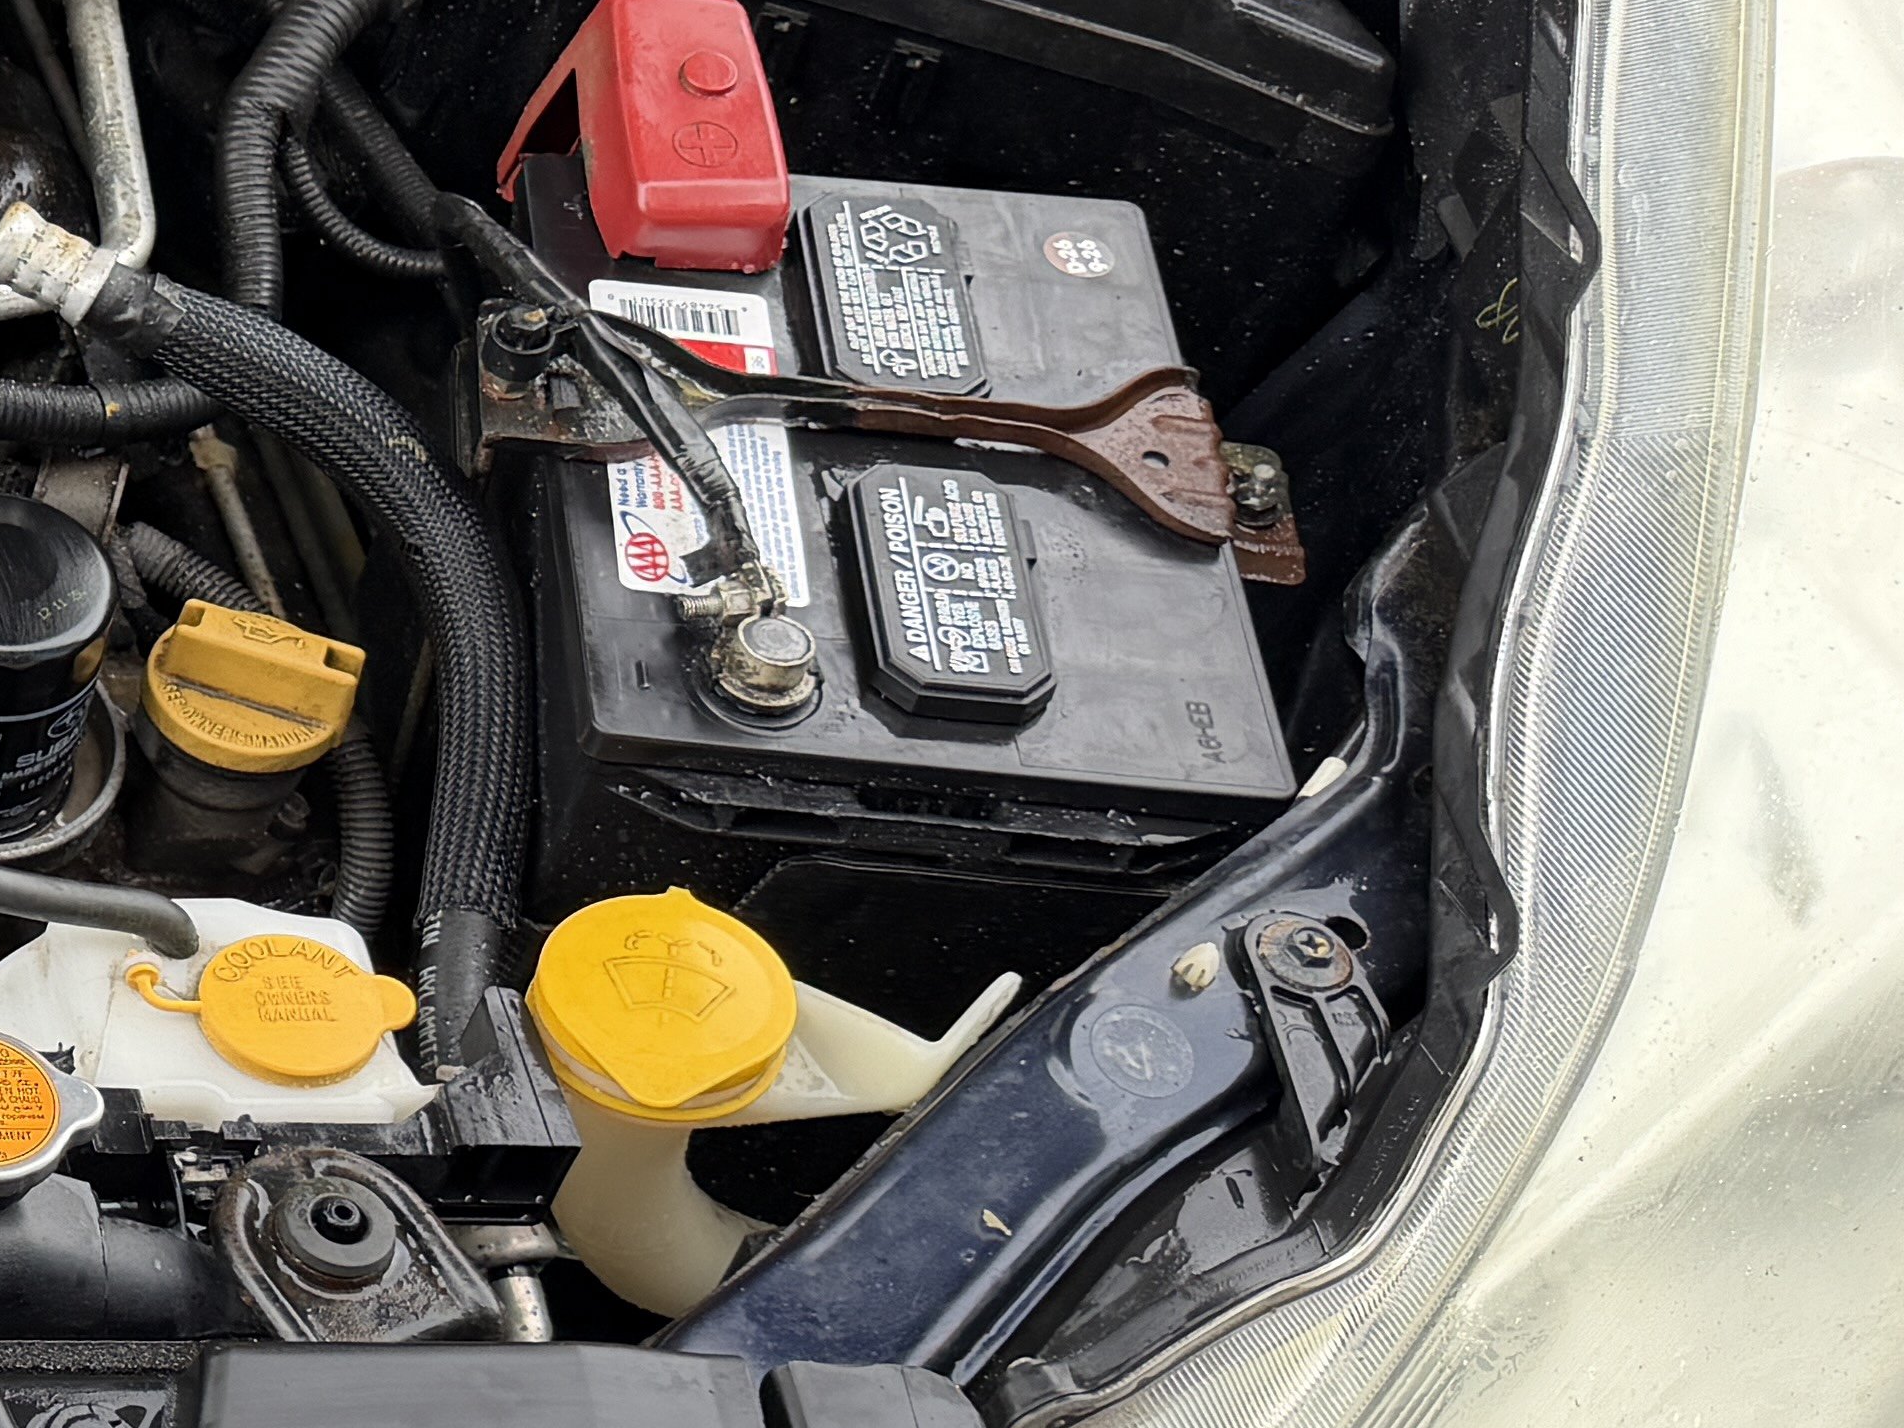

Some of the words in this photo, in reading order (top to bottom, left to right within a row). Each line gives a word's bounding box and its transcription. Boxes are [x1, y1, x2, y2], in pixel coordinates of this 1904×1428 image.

[628, 534, 668, 578] AAA
[213, 937, 359, 982] COOLANT
[262, 975, 305, 990] SEE
[258, 1006, 337, 1023] MANUAL
